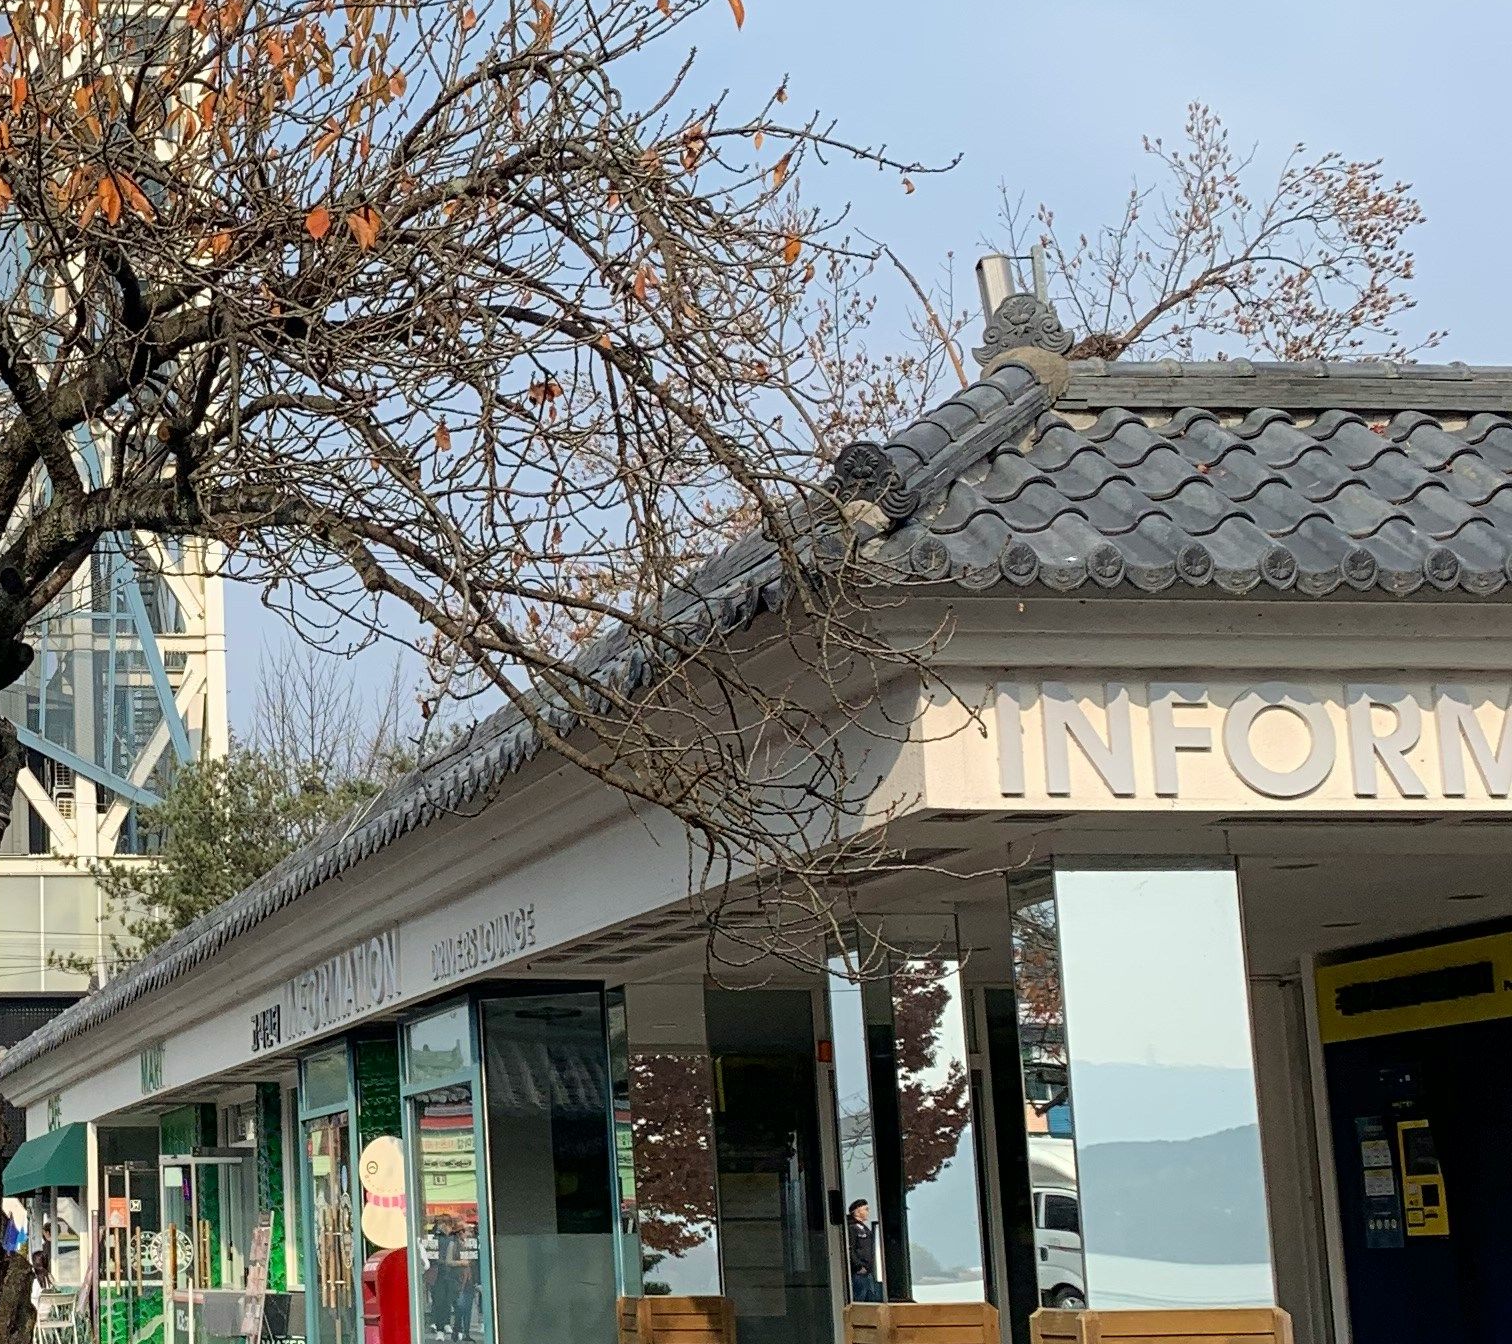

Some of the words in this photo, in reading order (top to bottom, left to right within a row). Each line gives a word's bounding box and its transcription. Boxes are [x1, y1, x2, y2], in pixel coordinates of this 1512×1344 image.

[995, 680, 1512, 799] INFORM
[283, 924, 402, 1039] INFORMATION
[431, 928, 478, 981] DRIVERS
[478, 903, 536, 963] LOUNGE
